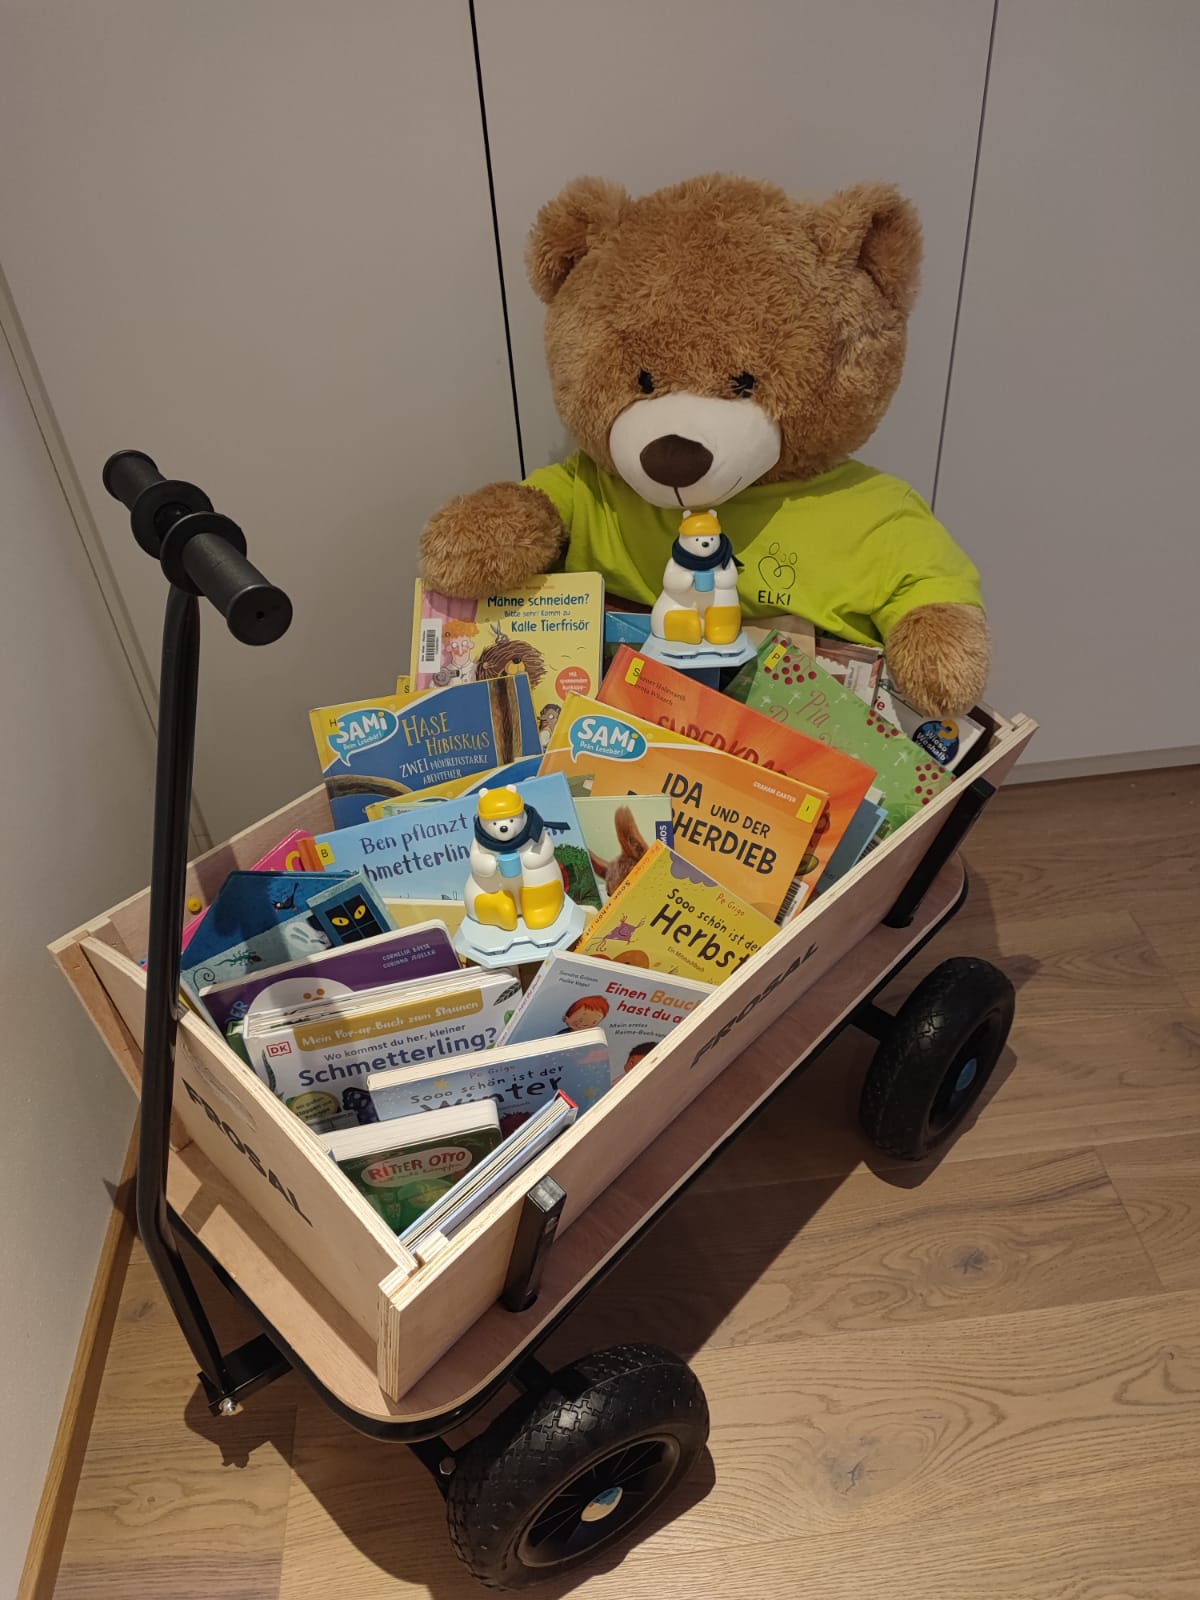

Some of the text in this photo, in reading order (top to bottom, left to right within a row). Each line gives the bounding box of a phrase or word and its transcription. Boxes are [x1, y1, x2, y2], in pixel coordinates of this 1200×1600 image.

[528, 593, 590, 606] schneiden?
[758, 590, 791, 606] ELKI
[511, 619, 590, 632] Kalle Tierfrisör
[772, 651, 781, 661] P
[632, 667, 641, 677] S
[404, 685, 410, 694] S
[796, 689, 833, 729] Pia
[329, 719, 338, 728] H
[425, 731, 491, 758] HIBISKUS
[926, 729, 948, 752] Wieso
[399, 758, 429, 778] ZWEI
[423, 769, 462, 785] ABENTEUER
[661, 772, 704, 809] IDA
[360, 812, 469, 854] Ben pflanzt
[710, 804, 772, 840] UND DER
[671, 808, 778, 875] HERDIEB
[321, 848, 331, 859] B
[667, 888, 696, 914] Sooo
[697, 911, 729, 934] schön
[728, 928, 746, 946] ist
[605, 982, 647, 1001] Einen
[616, 1000, 650, 1017] hast
[651, 1009, 671, 1021] du
[690, 942, 818, 1069] FROSAL
[302, 1034, 332, 1047] Mein
[408, 1014, 432, 1023] zum
[434, 1001, 480, 1018] Staunen
[269, 1044, 290, 1055] DK
[323, 1024, 467, 1062] Wo kommst du her, kleiner
[298, 1027, 497, 1087] Schmetterling?
[410, 1065, 564, 1104] Sooo schön ist der
[182, 1078, 313, 1228] FROSAL
[428, 1151, 466, 1167] OTTO
